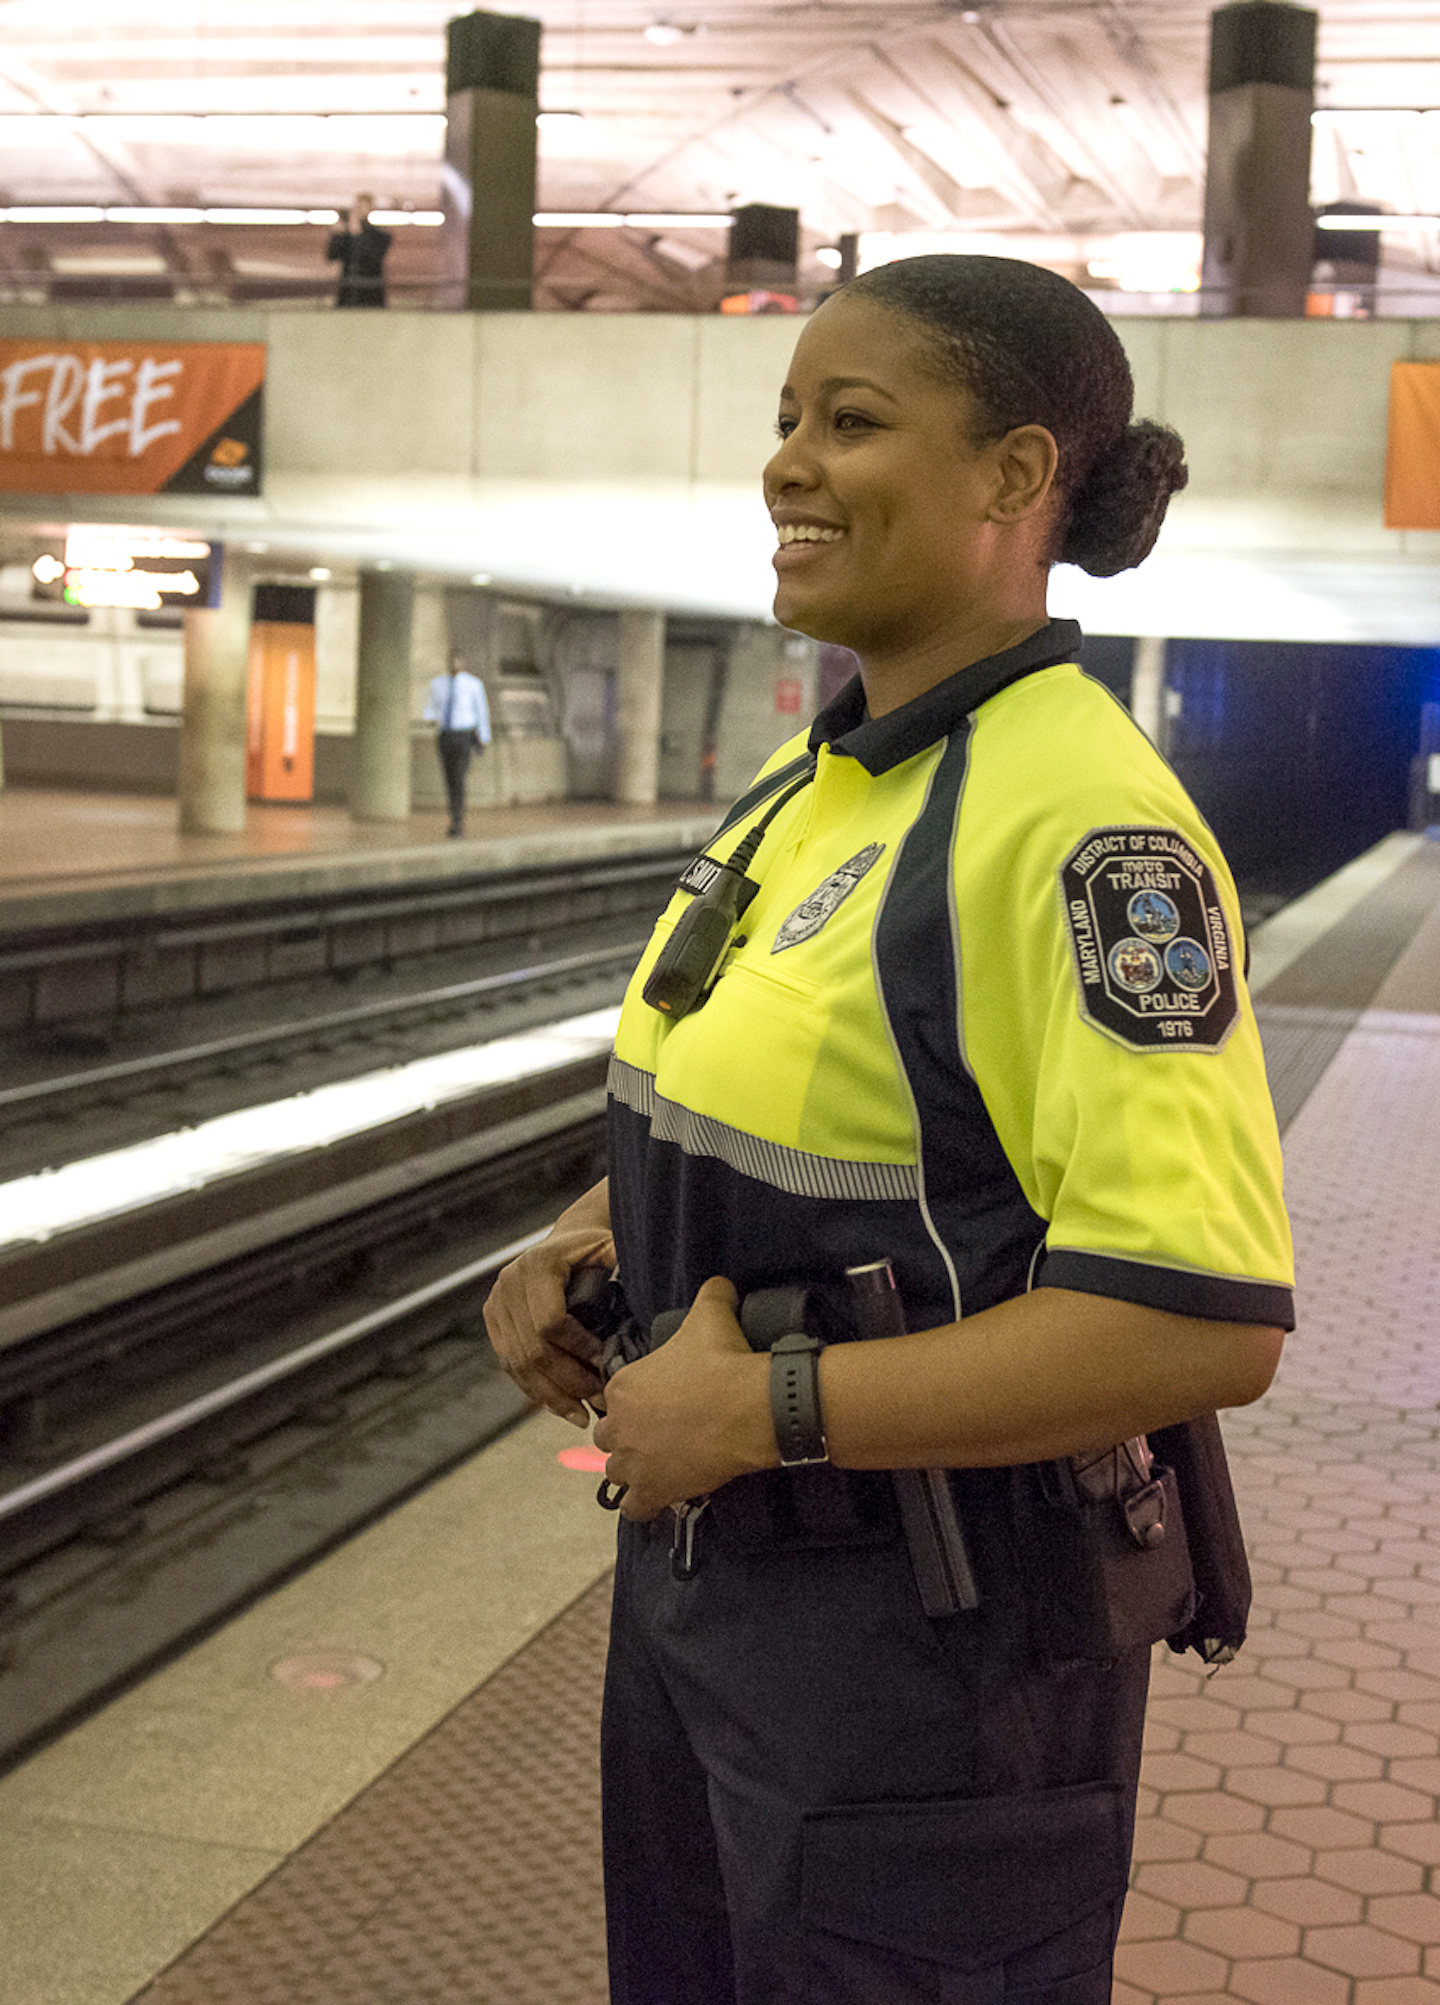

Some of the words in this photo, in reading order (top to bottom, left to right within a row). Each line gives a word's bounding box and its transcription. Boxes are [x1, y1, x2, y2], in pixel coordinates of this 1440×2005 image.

[0, 353, 183, 457] FREE
[1071, 836, 1127, 876] DISTRICT
[1129, 835, 1146, 850] OF
[1148, 836, 1204, 878] COLUMBIA
[1122, 860, 1164, 873] metro
[1107, 873, 1181, 890] TRANSIT
[1071, 900, 1101, 985] MARYLAND
[1208, 906, 1230, 971] VIRGINIA
[1139, 993, 1200, 1012] POLICE
[1157, 1020, 1193, 1038] 1976
